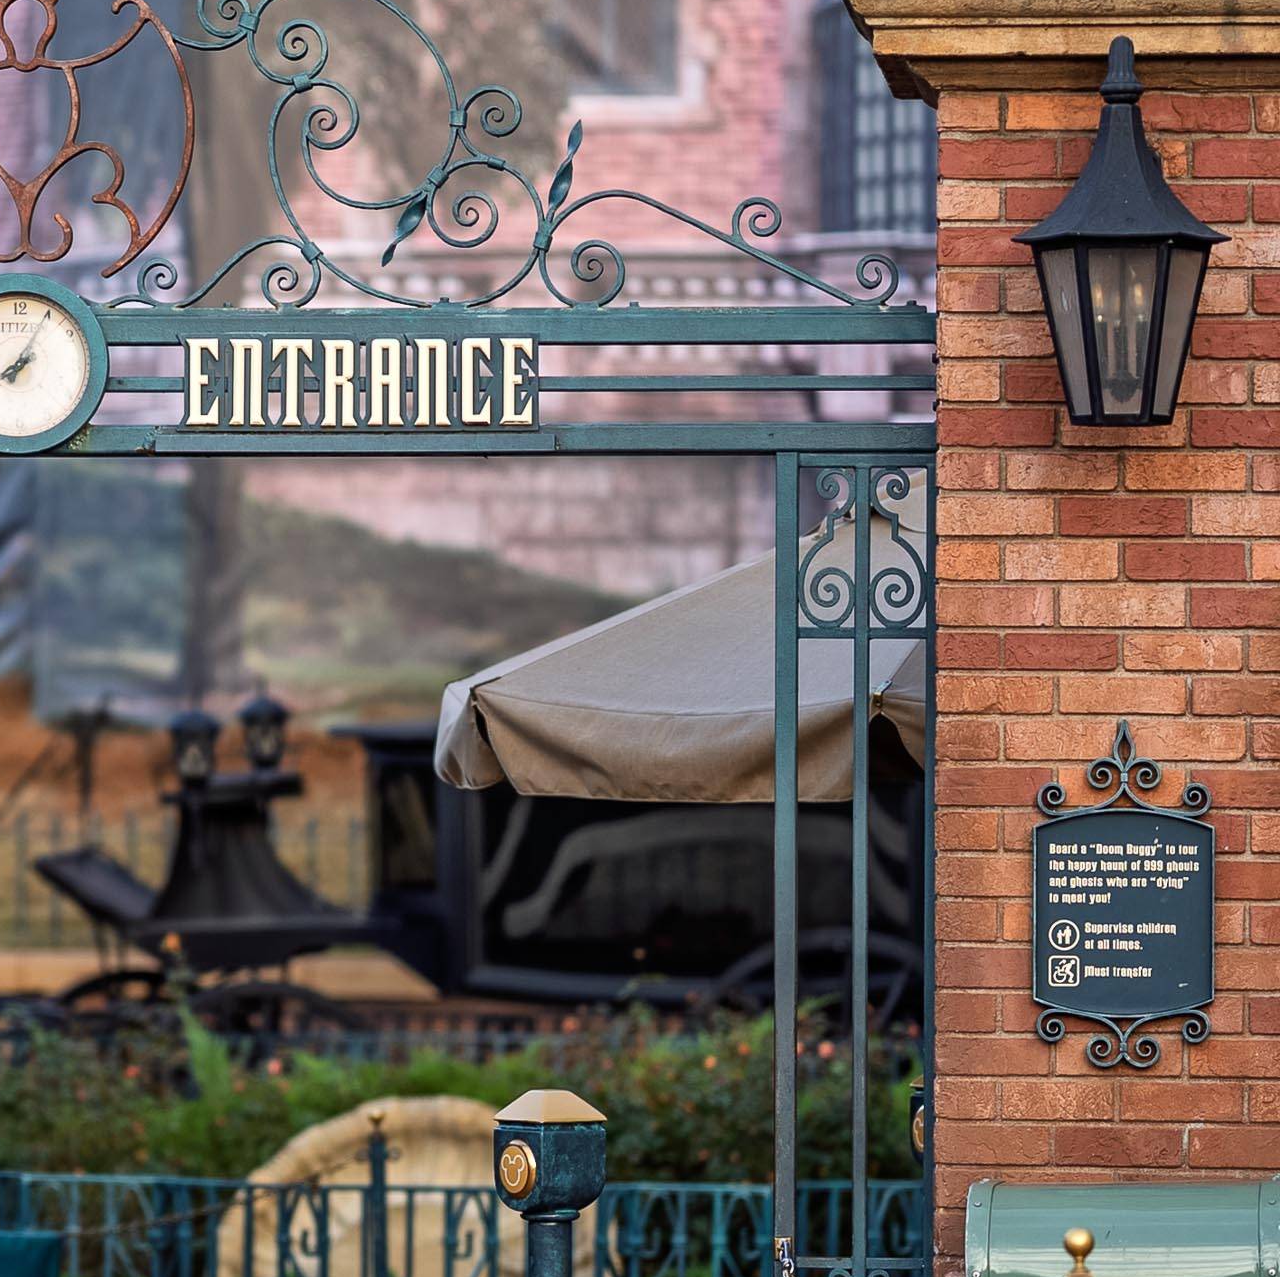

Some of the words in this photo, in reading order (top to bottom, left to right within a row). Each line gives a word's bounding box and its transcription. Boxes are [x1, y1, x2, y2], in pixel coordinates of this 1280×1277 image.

[13, 301, 28, 315] 12
[185, 338, 534, 427] ENTRANCE
[1049, 844, 1078, 855] Board
[1081, 845, 1087, 854] a
[1166, 845, 1175, 854] to
[1179, 845, 1198, 855] tour
[1049, 860, 1065, 871] the
[1068, 860, 1098, 872] happy
[1101, 860, 1127, 872] haunt
[1131, 860, 1141, 871] of
[1144, 860, 1163, 871] 999
[1167, 861, 1200, 873] ghouls
[1049, 876, 1067, 888] and
[1070, 876, 1103, 888] ghosts
[1106, 877, 1128, 888] who
[1131, 878, 1147, 888] are
[1049, 893, 1058, 903] to
[1062, 893, 1086, 904] meet
[1089, 893, 1112, 905] you!
[1085, 922, 1134, 935] Supervise
[1137, 923, 1177, 935] children
[1085, 940, 1094, 950] at
[1097, 940, 1109, 950] all
[1113, 939, 1144, 951] times.
[1085, 966, 1110, 978] Must
[1113, 967, 1153, 978] transfer
